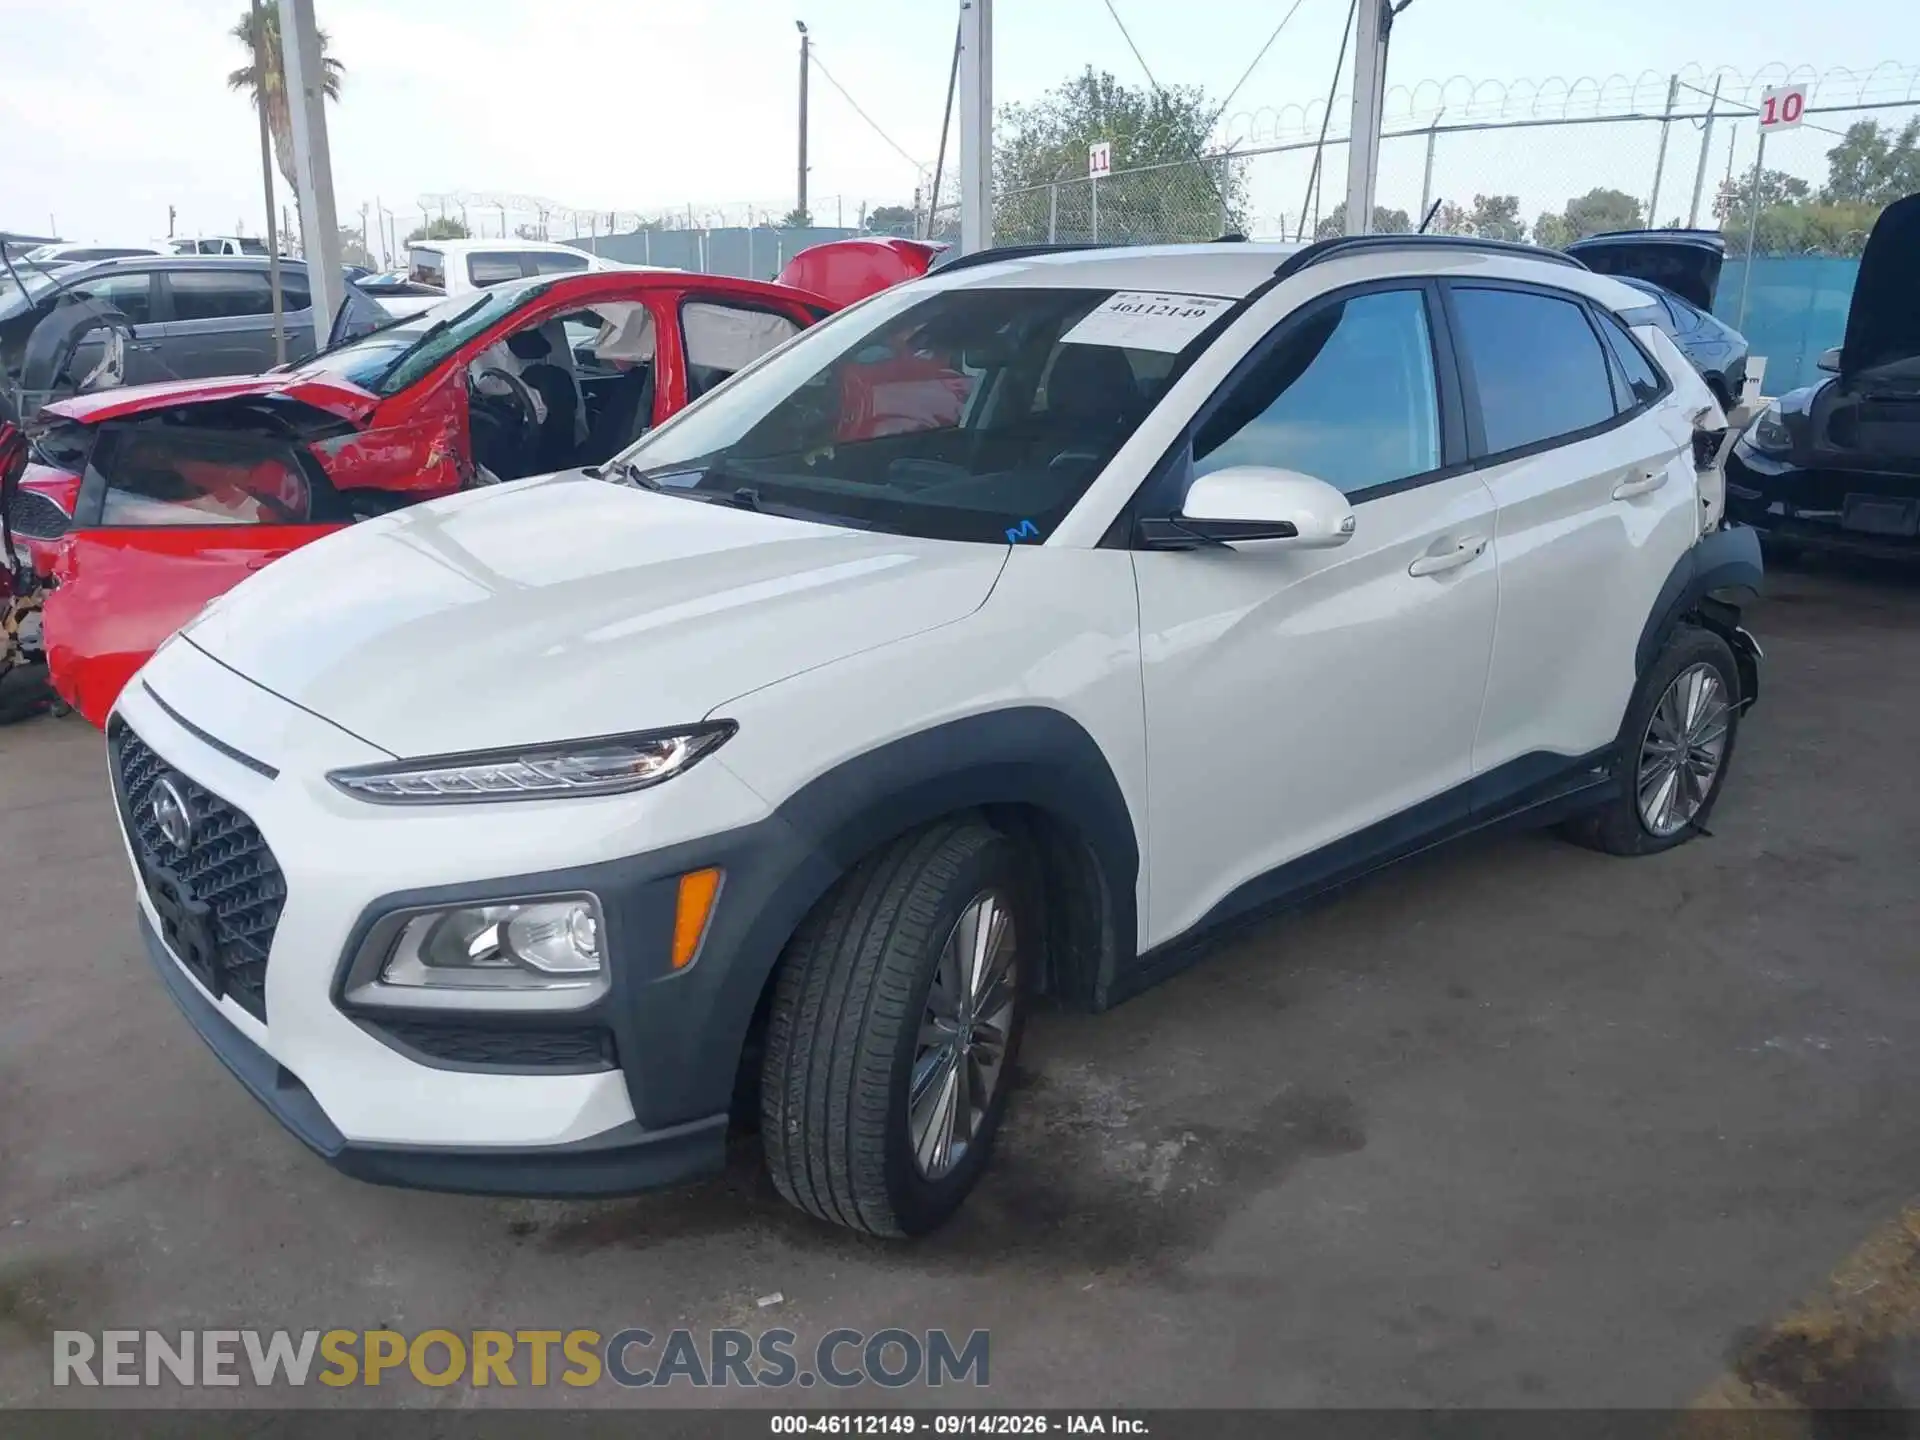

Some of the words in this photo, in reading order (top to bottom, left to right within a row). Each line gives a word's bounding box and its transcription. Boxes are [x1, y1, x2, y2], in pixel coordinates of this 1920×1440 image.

[1761, 92, 1803, 126] 10
[1091, 149, 1109, 172] 11
[1109, 302, 1206, 318] 46112149
